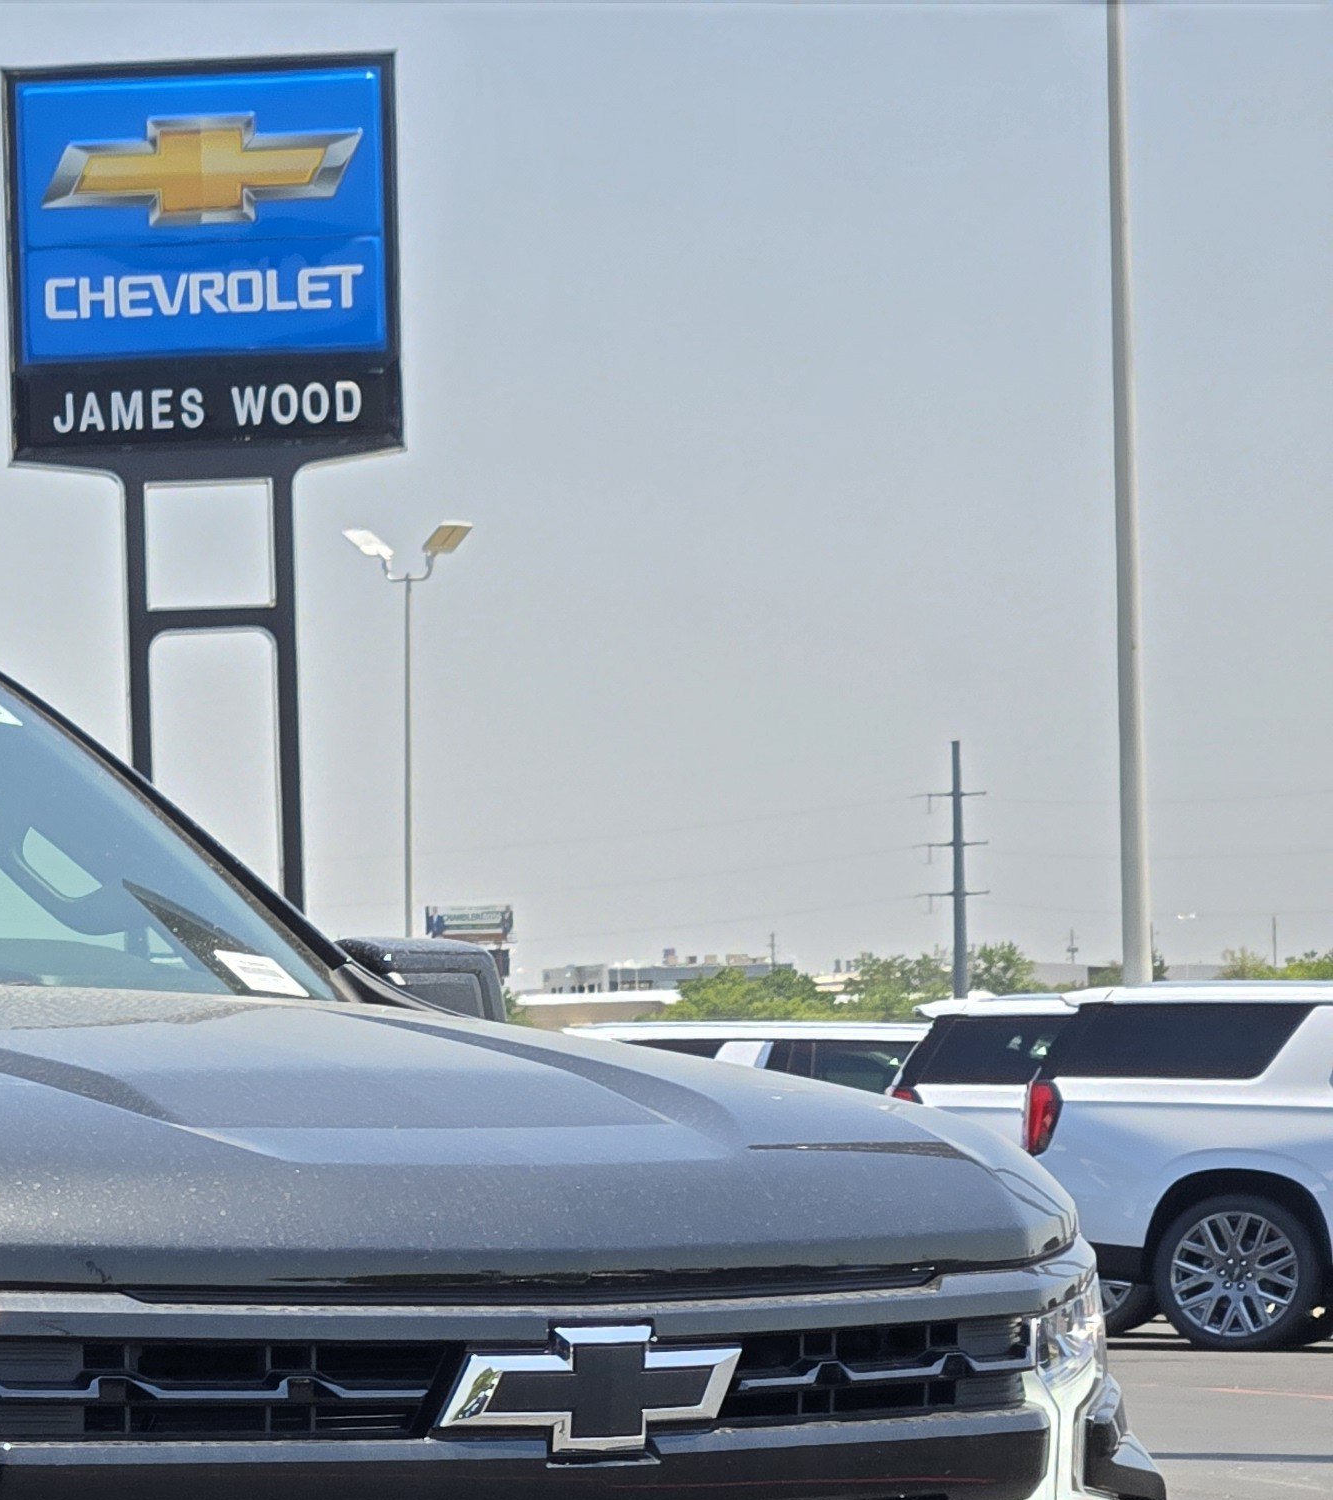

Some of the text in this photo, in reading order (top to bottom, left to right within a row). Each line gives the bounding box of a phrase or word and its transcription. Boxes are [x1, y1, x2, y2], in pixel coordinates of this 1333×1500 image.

[44, 263, 364, 320] CHEVROLET
[52, 380, 363, 434] JAMES WOOD
